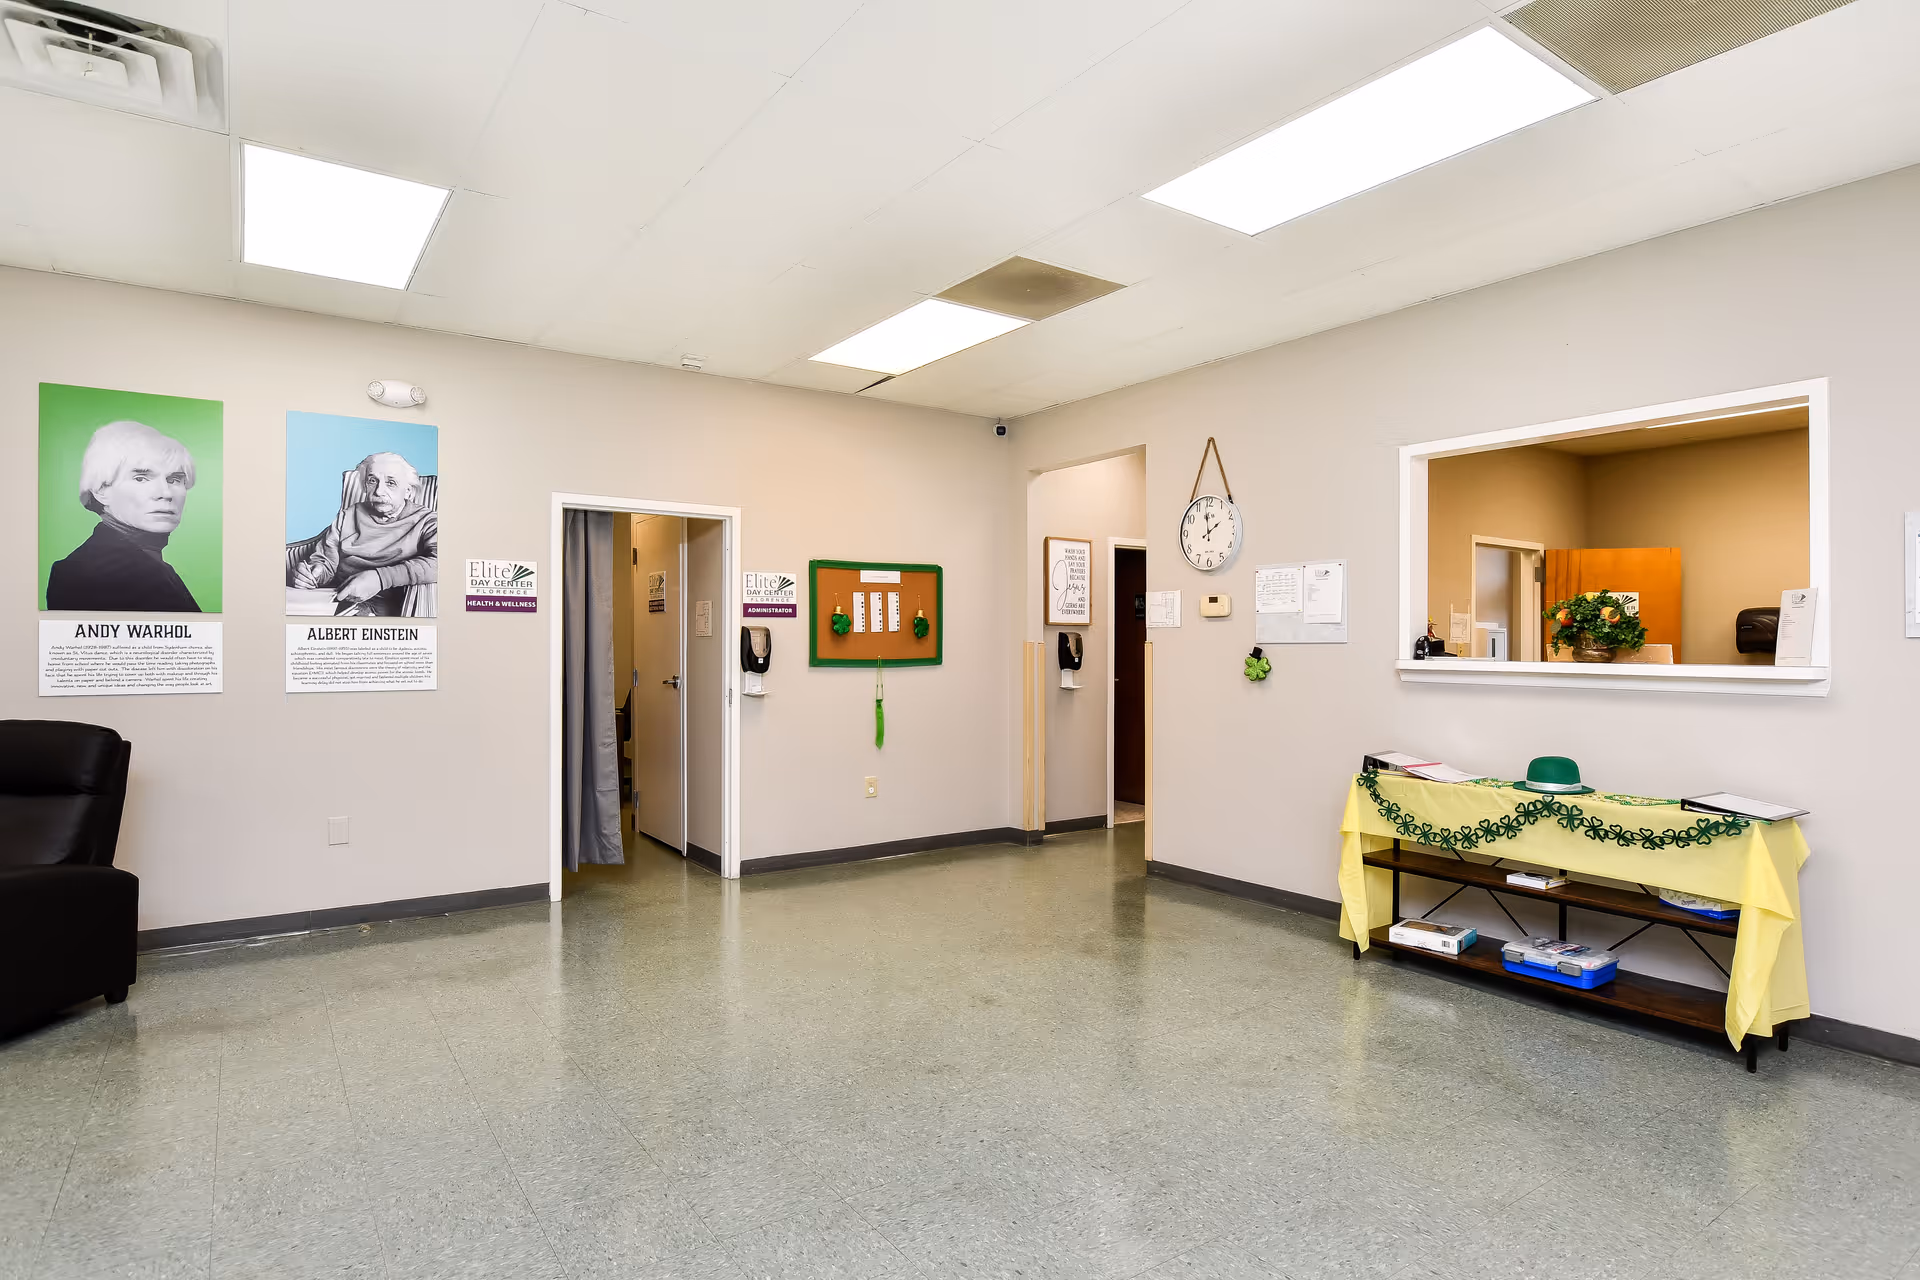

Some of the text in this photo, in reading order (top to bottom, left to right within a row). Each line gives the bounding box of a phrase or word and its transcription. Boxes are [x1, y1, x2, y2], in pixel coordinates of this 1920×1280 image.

[1196, 502, 1201, 512] 11
[1206, 498, 1214, 507] 12
[1220, 500, 1223, 510] 1
[1187, 514, 1195, 524] 10
[1228, 510, 1234, 520] 2
[1183, 530, 1188, 539] 9
[1187, 544, 1192, 554] 8
[1196, 554, 1201, 564] 7
[1219, 552, 1224, 562] 5
[1206, 557, 1212, 568] 6
[1052, 560, 1085, 611] Jesus
[75, 624, 191, 638] ANDY WARHOL
[307, 628, 418, 640] ALBERT EINSTEIN
